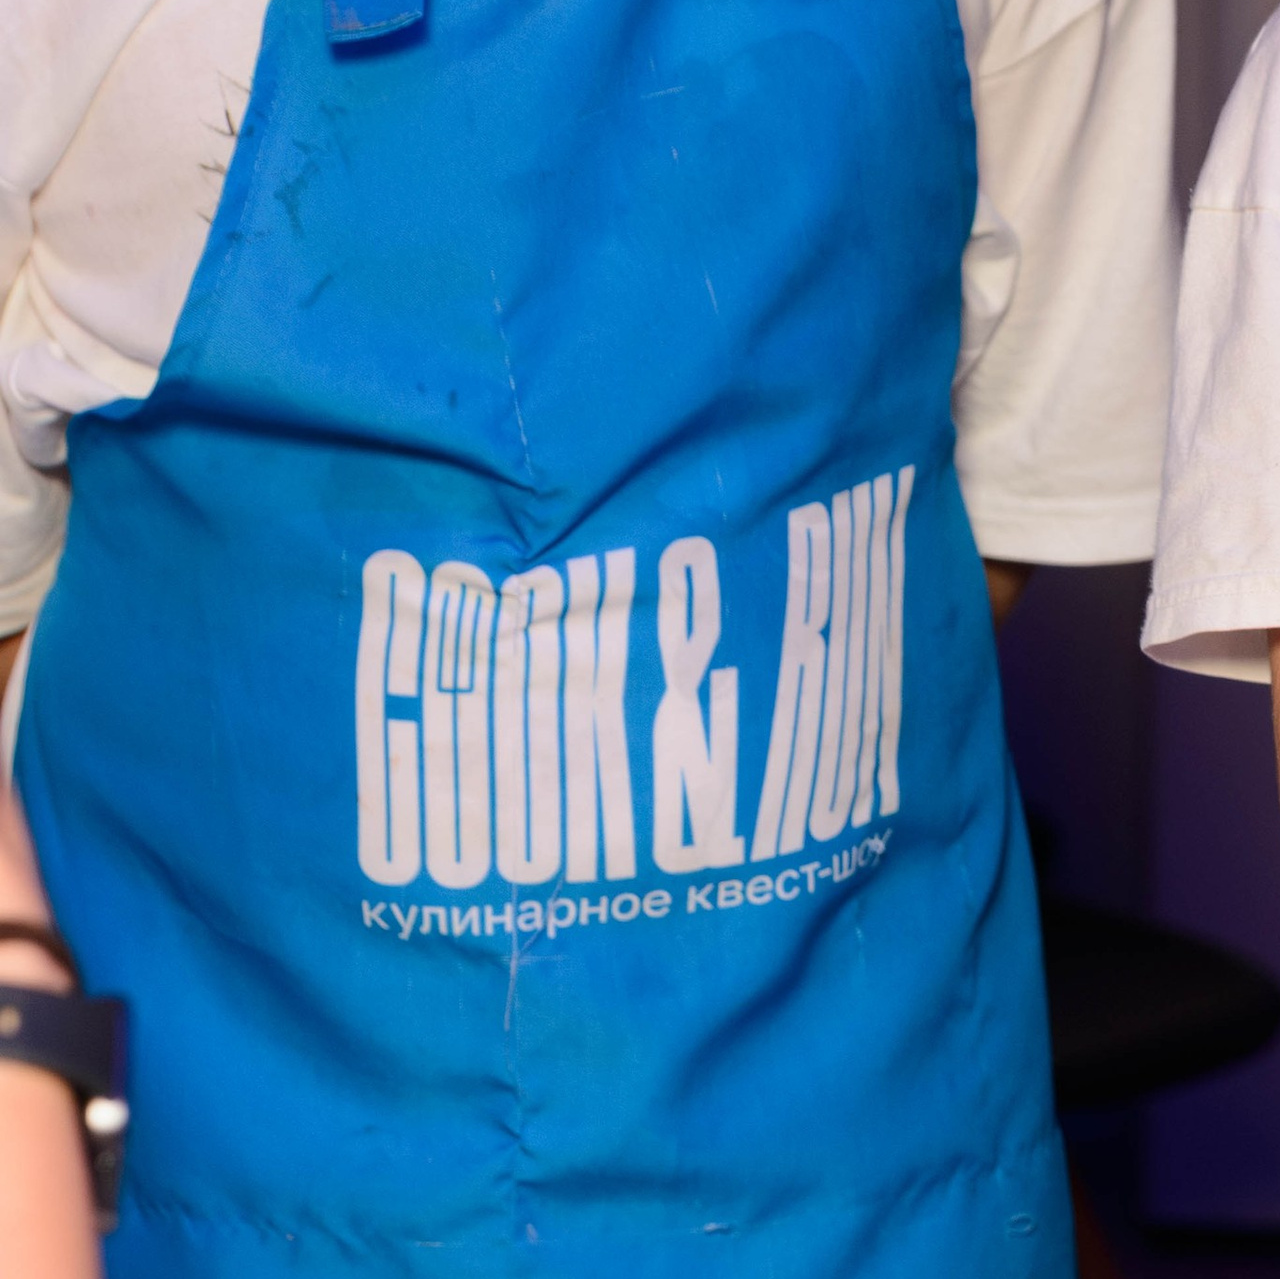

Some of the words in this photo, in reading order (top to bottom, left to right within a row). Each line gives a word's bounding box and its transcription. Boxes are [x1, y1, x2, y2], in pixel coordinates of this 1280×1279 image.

[356, 548, 636, 888] COOK
[652, 536, 745, 874] &
[750, 465, 915, 862] RUN
[362, 890, 672, 939] кулинарное
[687, 830, 892, 913] квест-шоу
